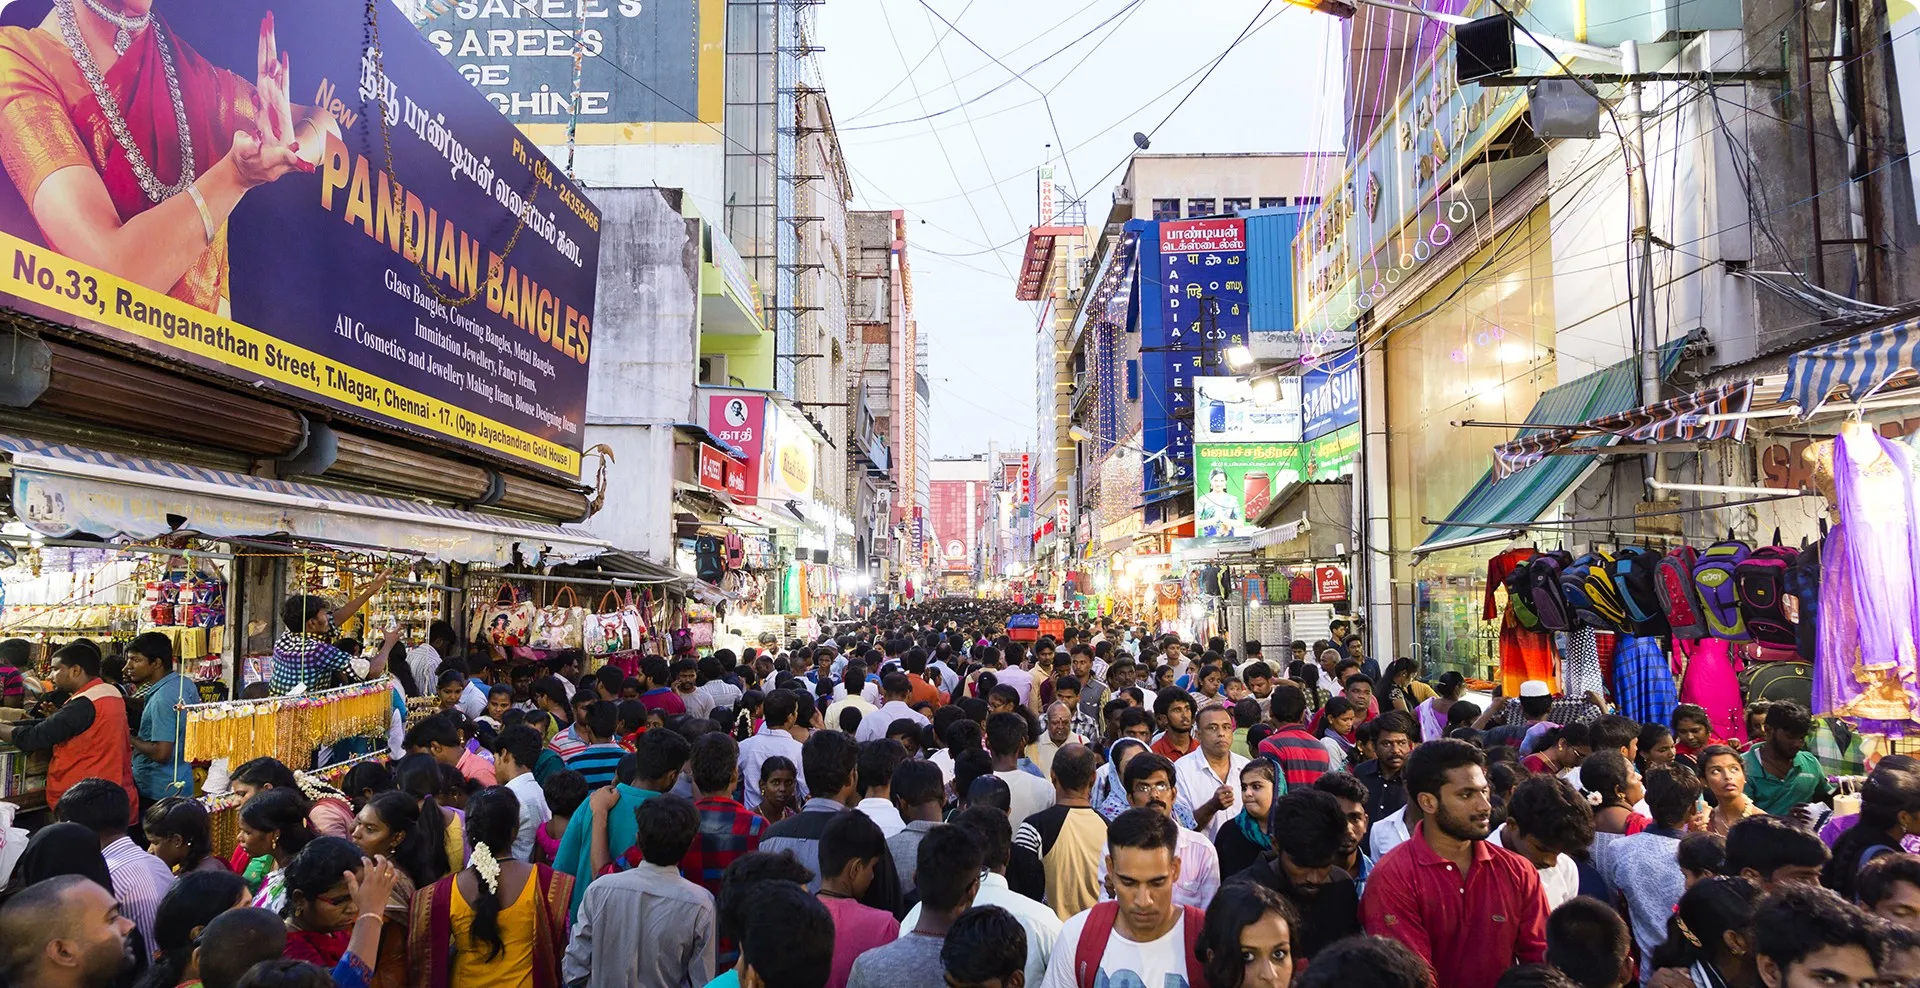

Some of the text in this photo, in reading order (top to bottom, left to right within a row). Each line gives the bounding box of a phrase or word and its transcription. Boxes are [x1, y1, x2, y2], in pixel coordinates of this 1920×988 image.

[427, 29, 604, 57] SAREES
[315, 77, 358, 130] New
[404, 95, 495, 196] பாண்டியன்
[557, 230, 583, 268] கடை
[512, 137, 527, 167] Ph
[534, 159, 554, 190] 044
[559, 183, 600, 233] 24355466
[1042, 181, 1053, 228] SHANMU
[321, 130, 591, 365] PANDIAN BANGLES
[1162, 238, 1244, 252] டெக்ஸ்டைல்ஸ்
[1166, 224, 1239, 241] பாண்டியன்
[13, 249, 106, 316] No.33,
[115, 287, 259, 362] Ranganathan
[265, 343, 321, 388] Street,
[325, 364, 381, 407] T.Nagar,
[384, 386, 430, 420] Chennai
[438, 406, 454, 428] 17.
[455, 417, 477, 438] (Opp
[478, 420, 532, 454] Jayachandran
[532, 440, 549, 459] Gold
[548, 450, 568, 467] House
[384, 268, 556, 381] Glass Bangles, Covering Bangles, Metal Bangles,
[414, 316, 537, 396] Immitation Jewellery, Fancy Items,
[334, 312, 577, 435] All Cosmetics and Jewellery Making Items, Blouse Designing Items
[1173, 363, 1187, 476] TEXILES
[1022, 454, 1030, 503] SHOBHA
[1058, 498, 1069, 532] RASI
